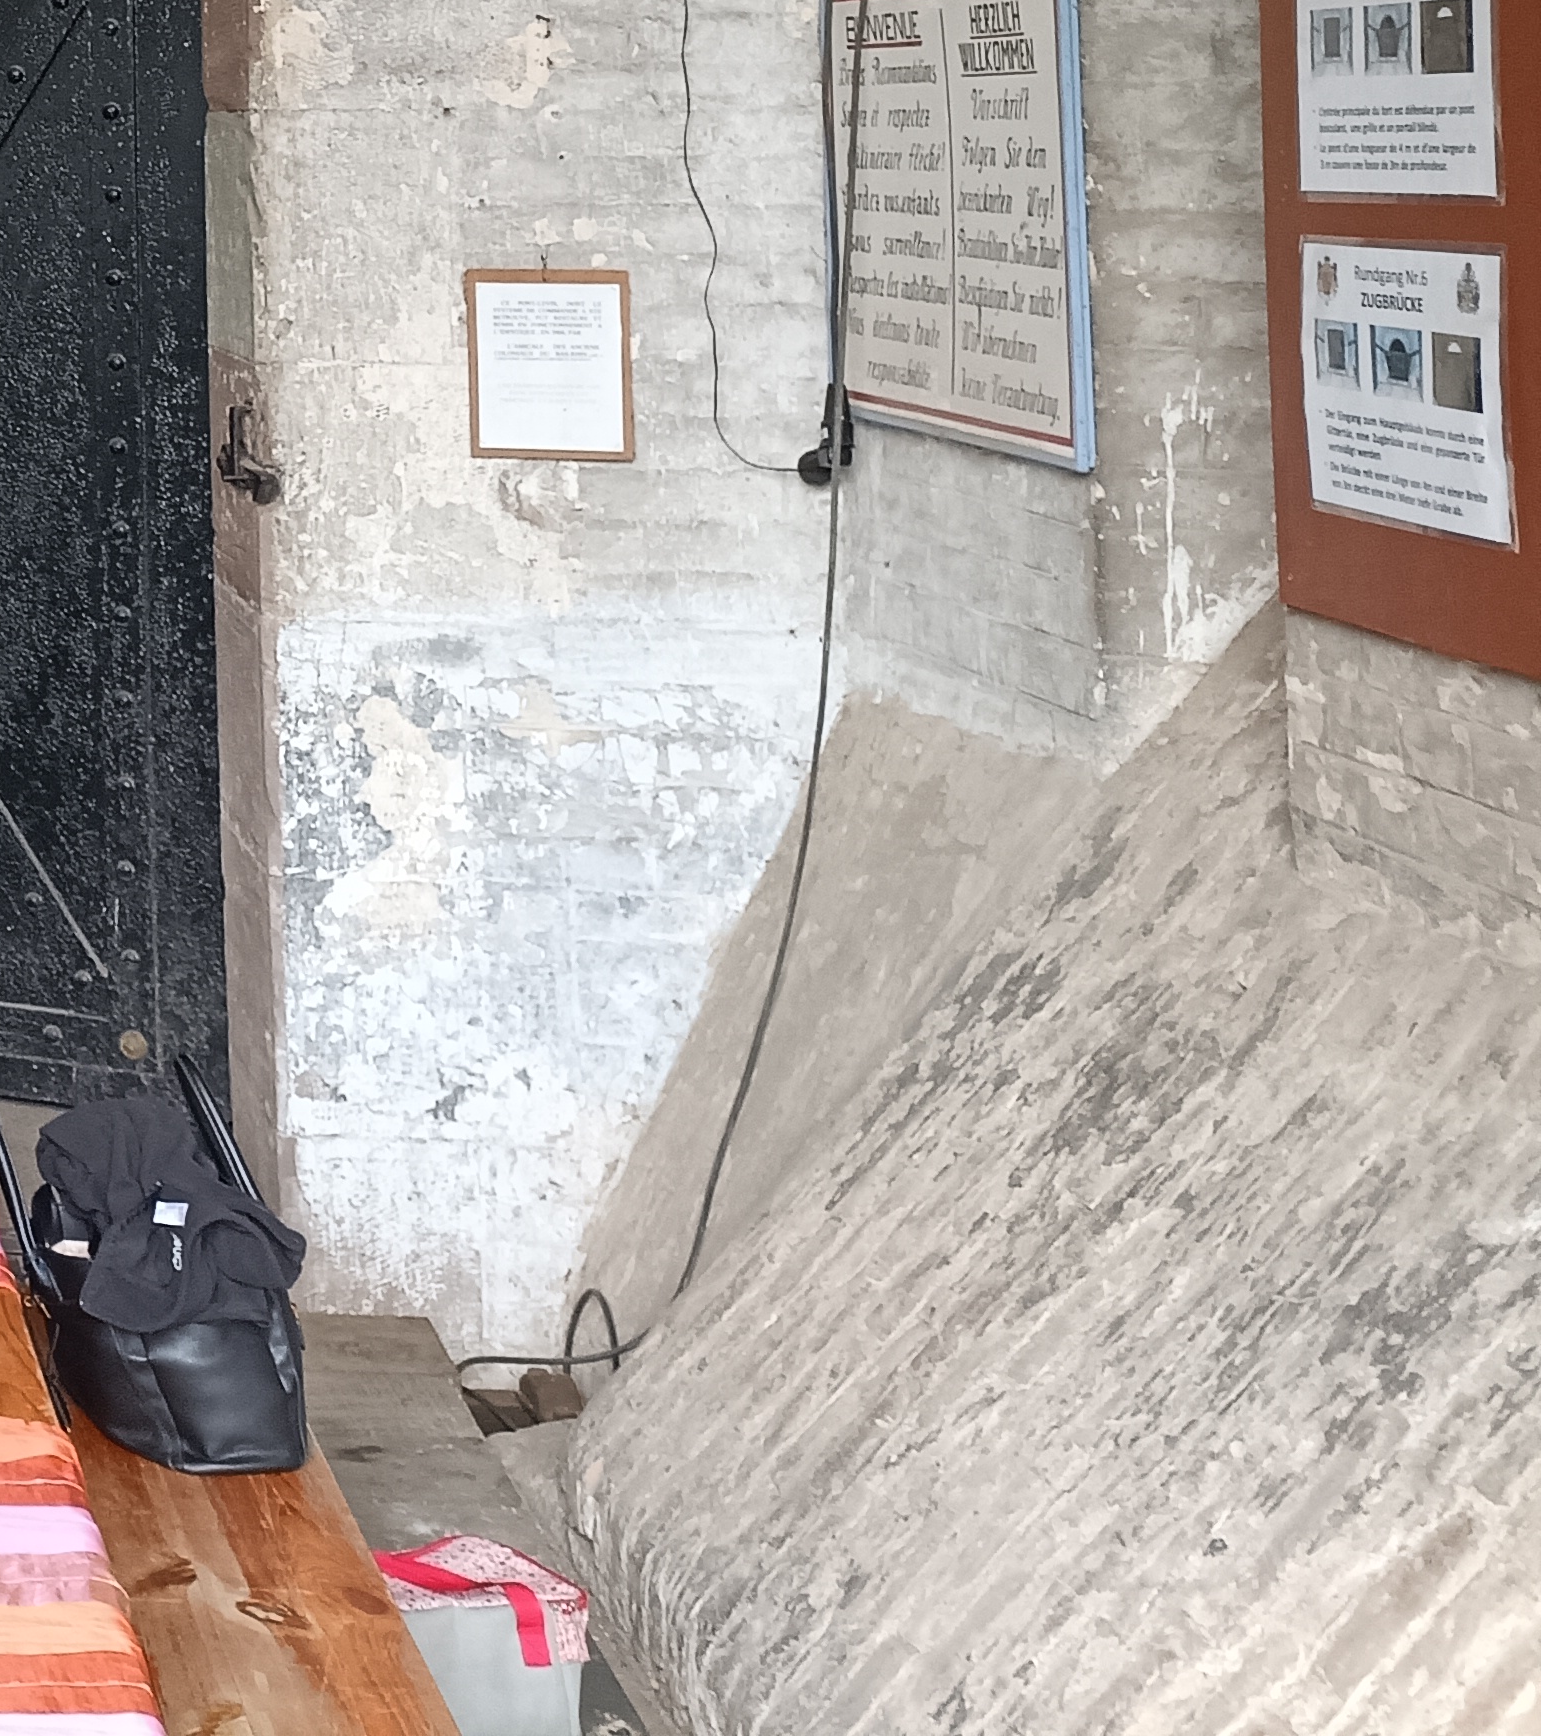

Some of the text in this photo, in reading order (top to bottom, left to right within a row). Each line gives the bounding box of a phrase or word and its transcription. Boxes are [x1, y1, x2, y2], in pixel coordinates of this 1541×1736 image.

[846, 10, 921, 43] BINVENUE
[969, 0, 1022, 34] HERZLICH
[957, 38, 1035, 73] WILLKOMMEN
[1004, 135, 1022, 170] Sie
[1354, 265, 1405, 288] Rundgang
[1360, 292, 1424, 313] ZUGBRÜCKE
